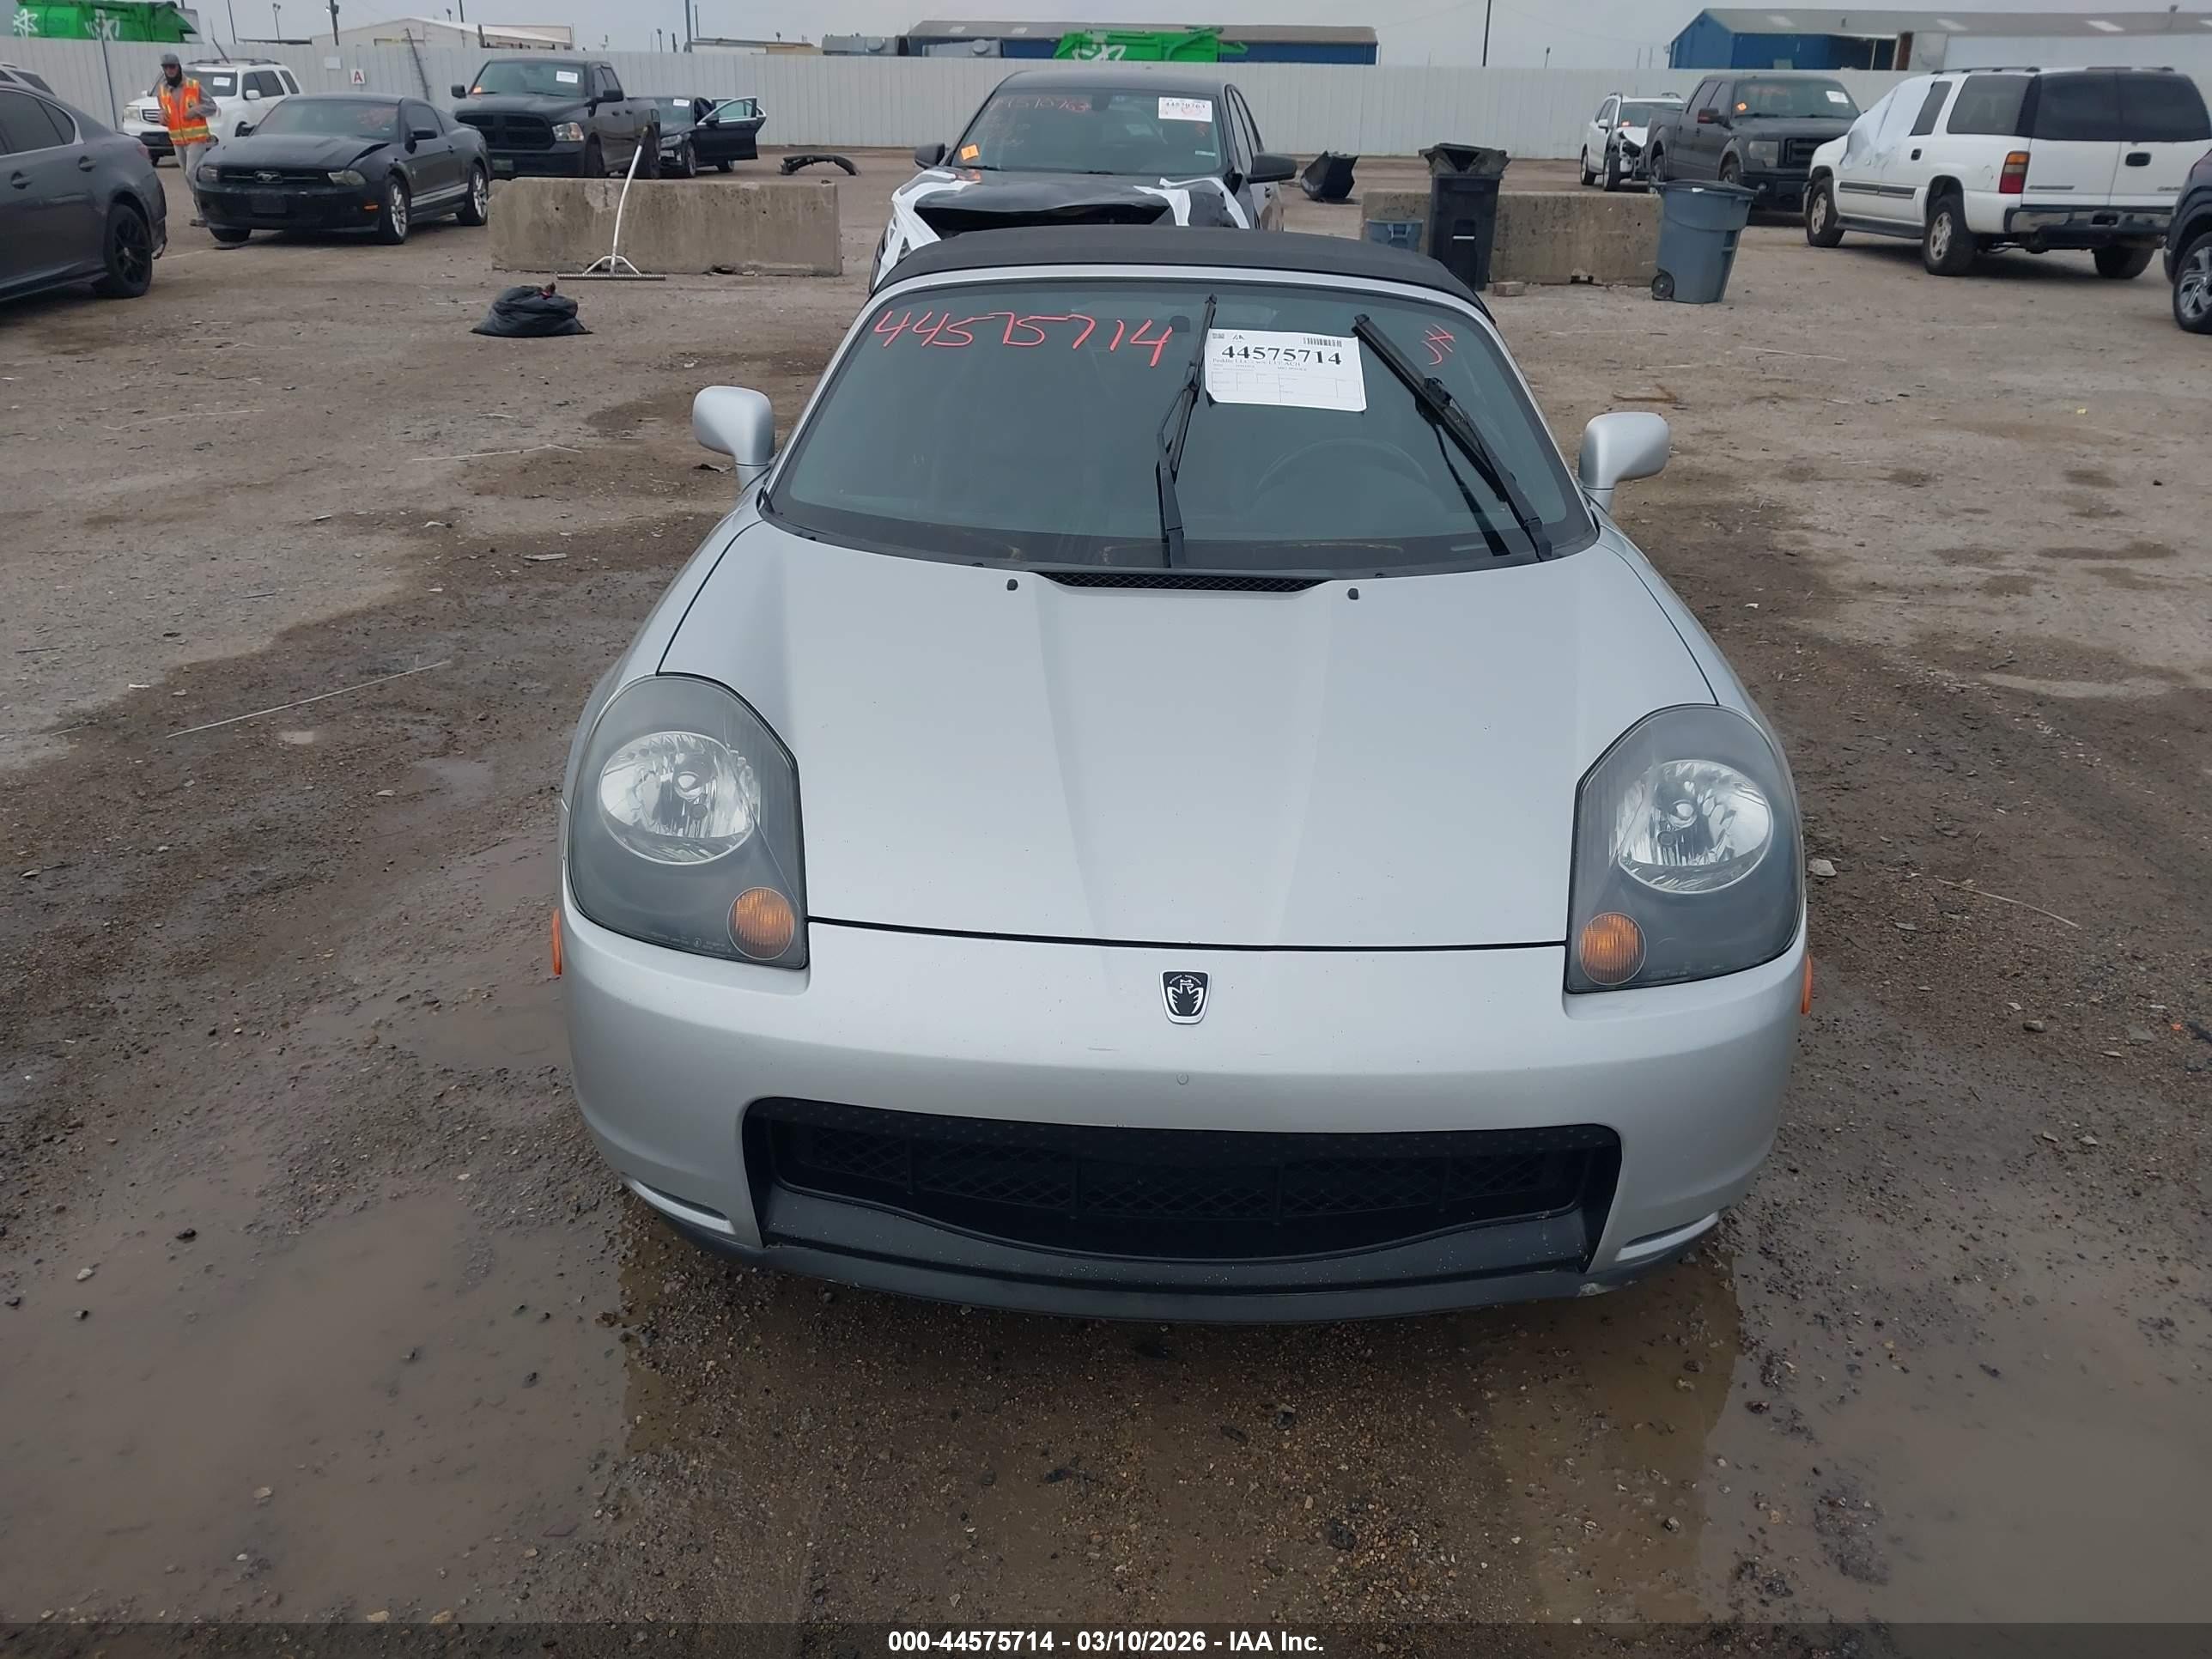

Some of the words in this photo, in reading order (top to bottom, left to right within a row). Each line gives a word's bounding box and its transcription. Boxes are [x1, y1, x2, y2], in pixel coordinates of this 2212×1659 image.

[354, 70, 363, 83] A
[874, 311, 1173, 367] 44575714
[1222, 345, 1342, 365] 44575714
